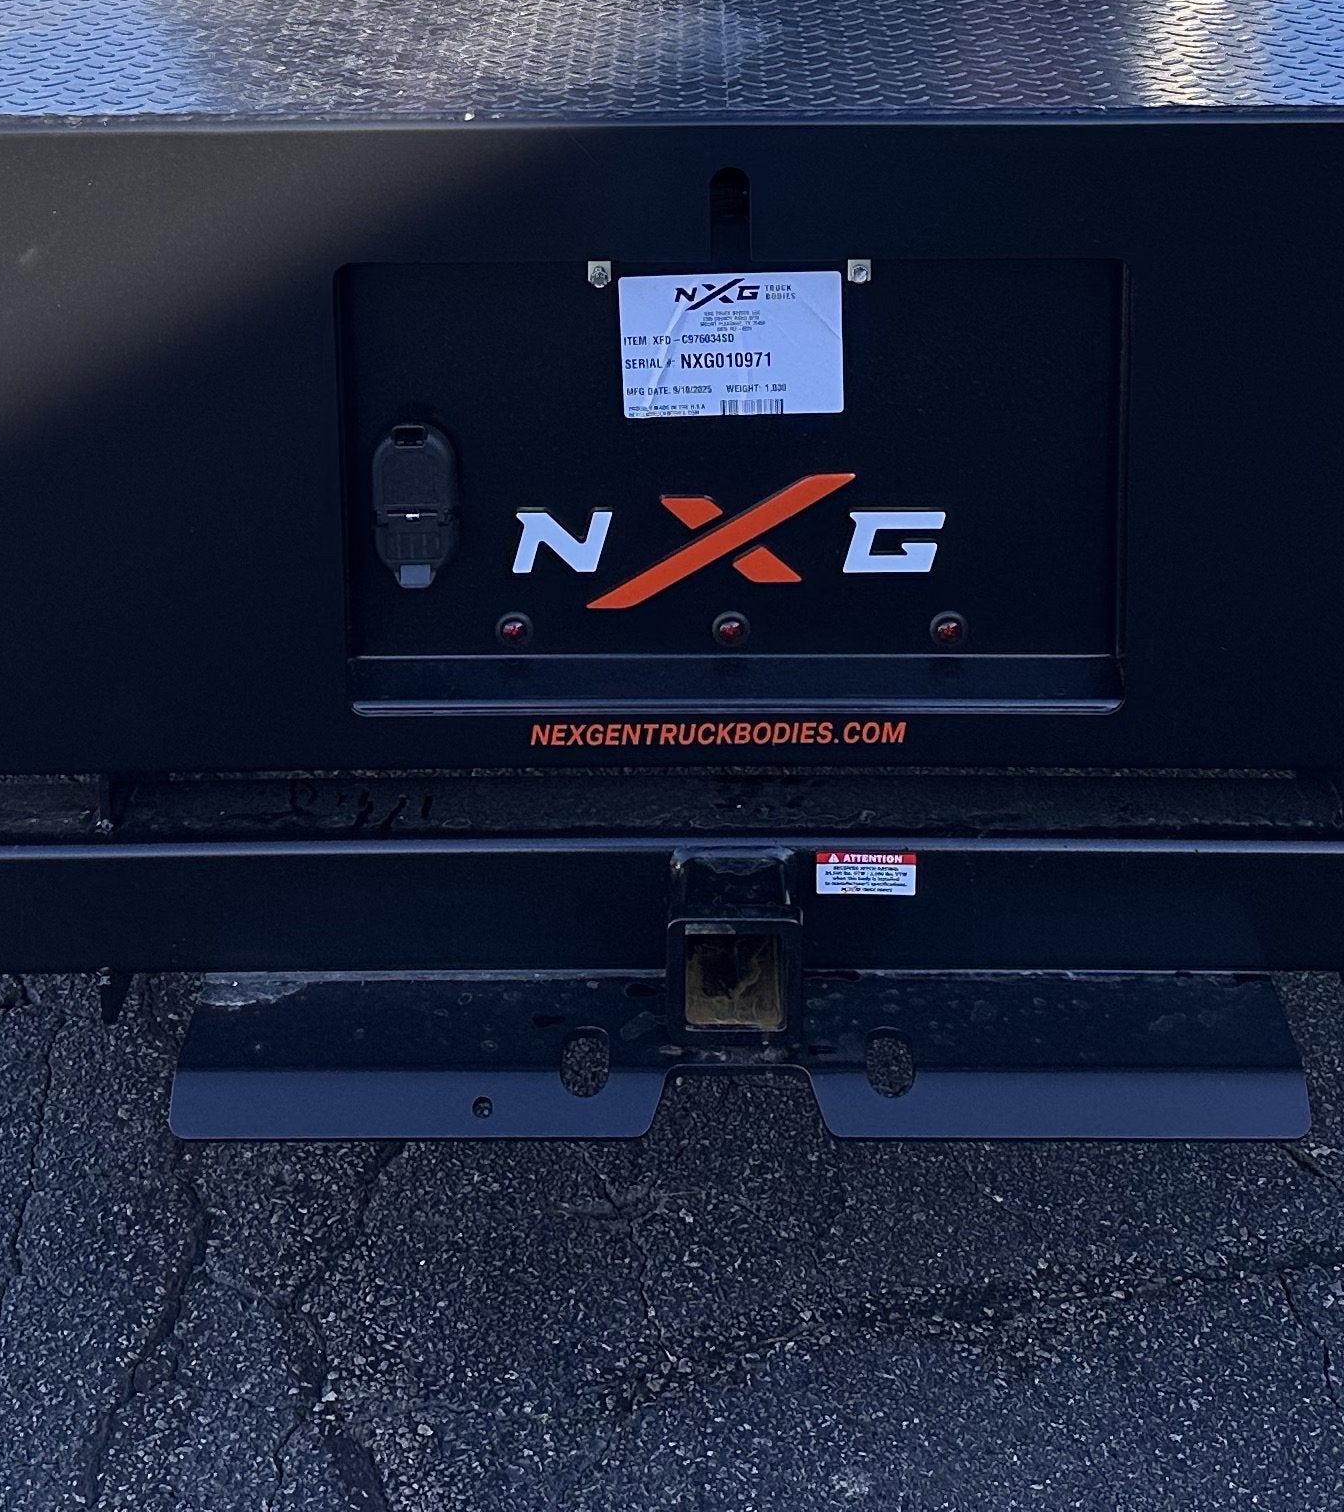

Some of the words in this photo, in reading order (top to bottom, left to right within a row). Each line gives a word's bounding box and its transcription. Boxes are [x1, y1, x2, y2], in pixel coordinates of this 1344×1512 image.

[764, 284, 792, 292] TRUCK
[674, 277, 761, 311] NXG
[765, 292, 796, 300] BODIES
[625, 357, 663, 369] SERIAL
[680, 351, 772, 369] NXG010971
[626, 387, 645, 396] MFG
[529, 721, 907, 747] NEXGENTRUCKBODIES.COM
[843, 854, 903, 864] ATTENTION
